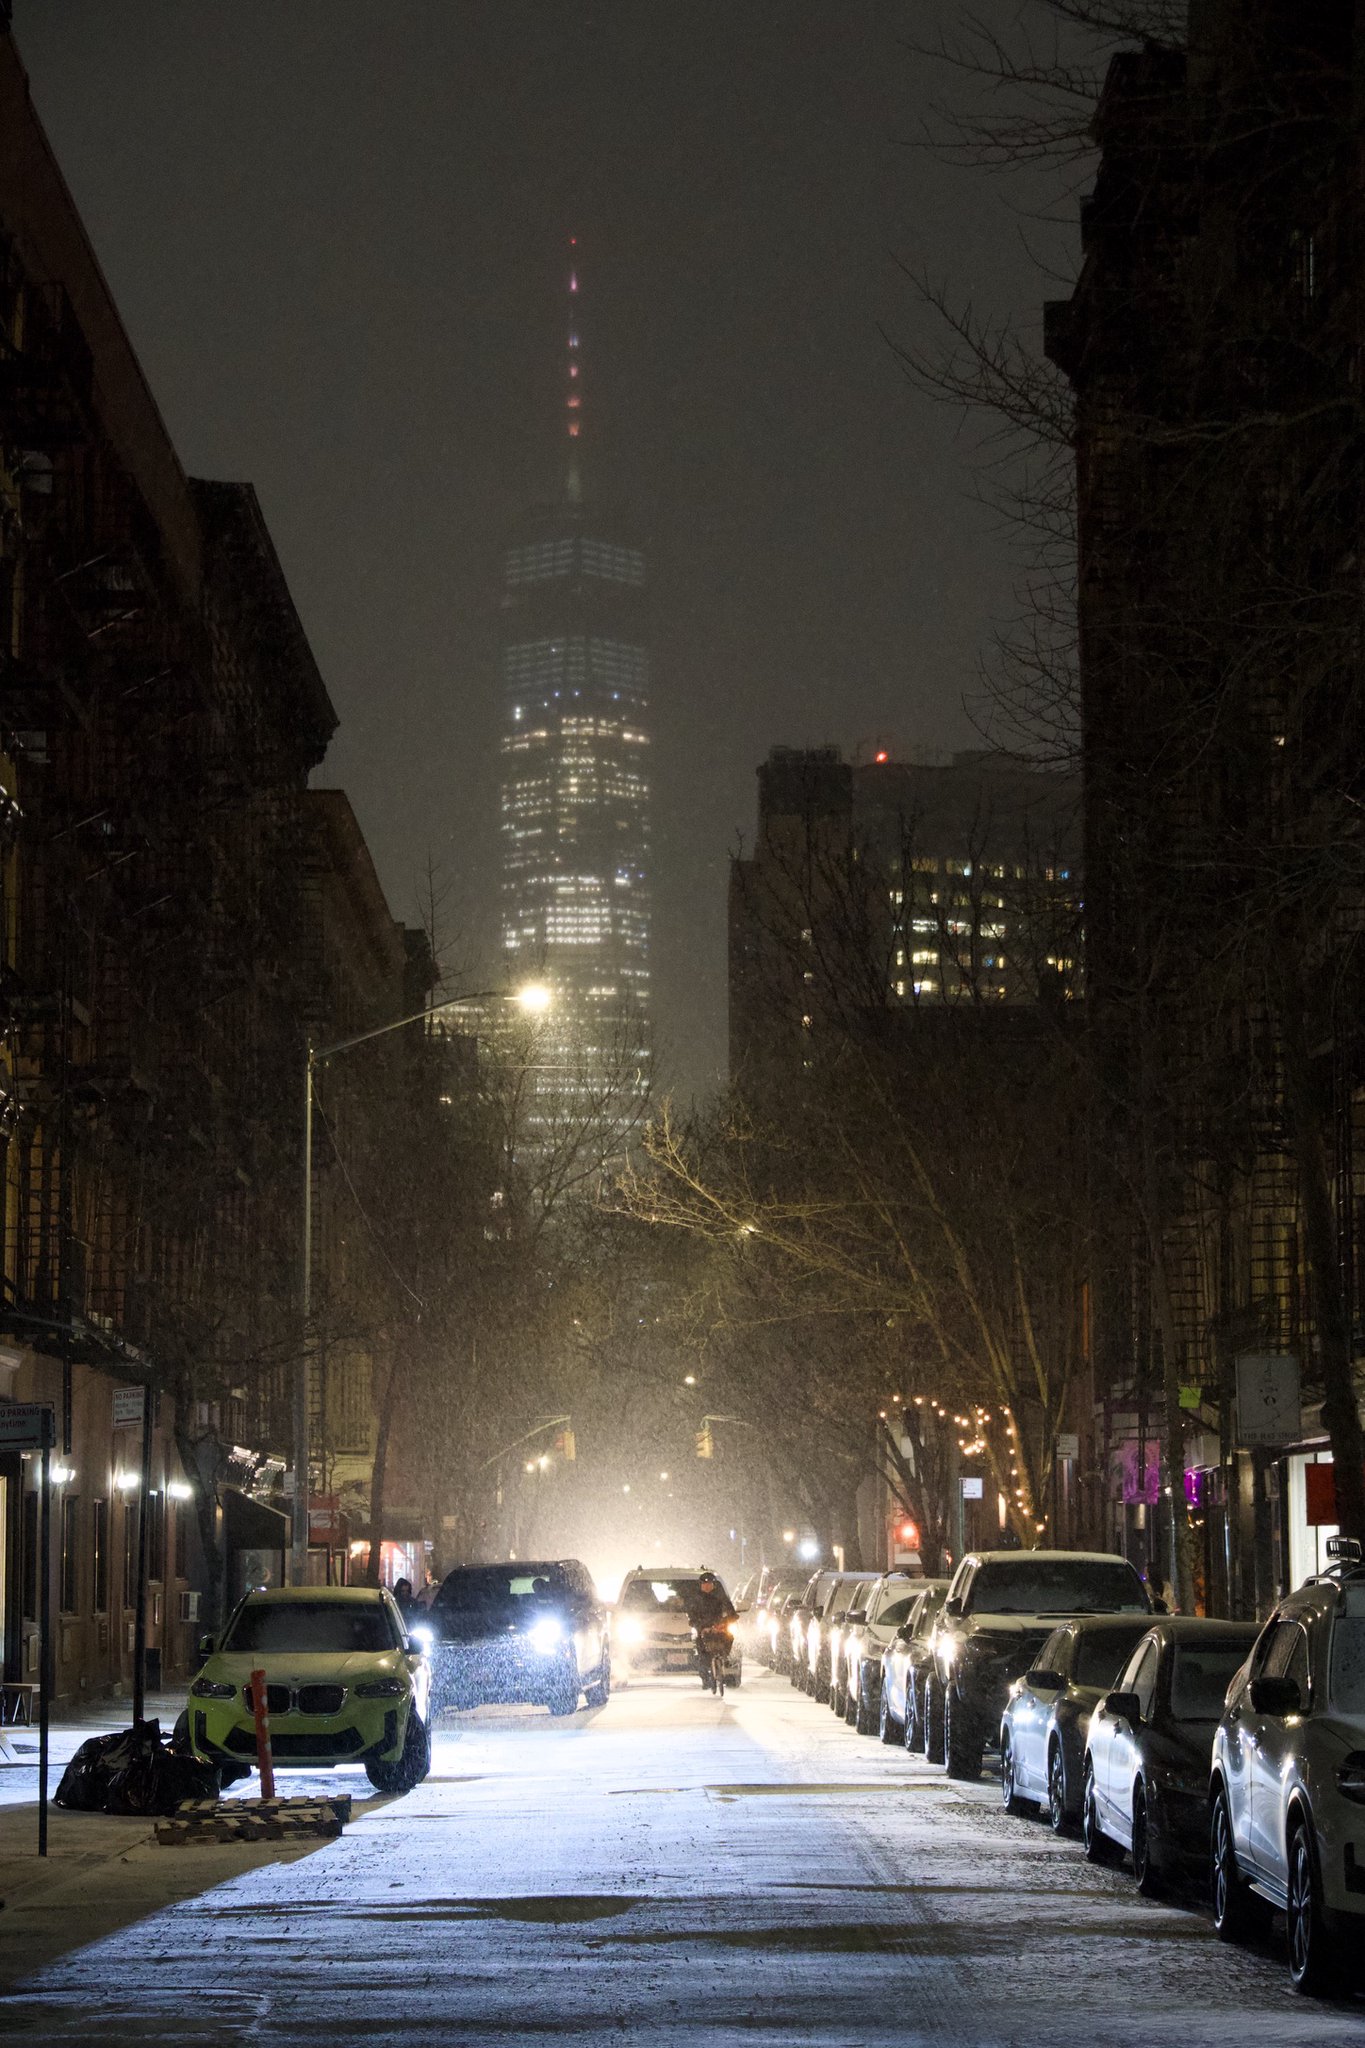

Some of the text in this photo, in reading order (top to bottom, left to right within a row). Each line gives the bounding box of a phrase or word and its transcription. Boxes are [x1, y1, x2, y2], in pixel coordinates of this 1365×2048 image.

[0, 1406, 40, 1418] O PARKING
[0, 1419, 26, 1430] nytime
